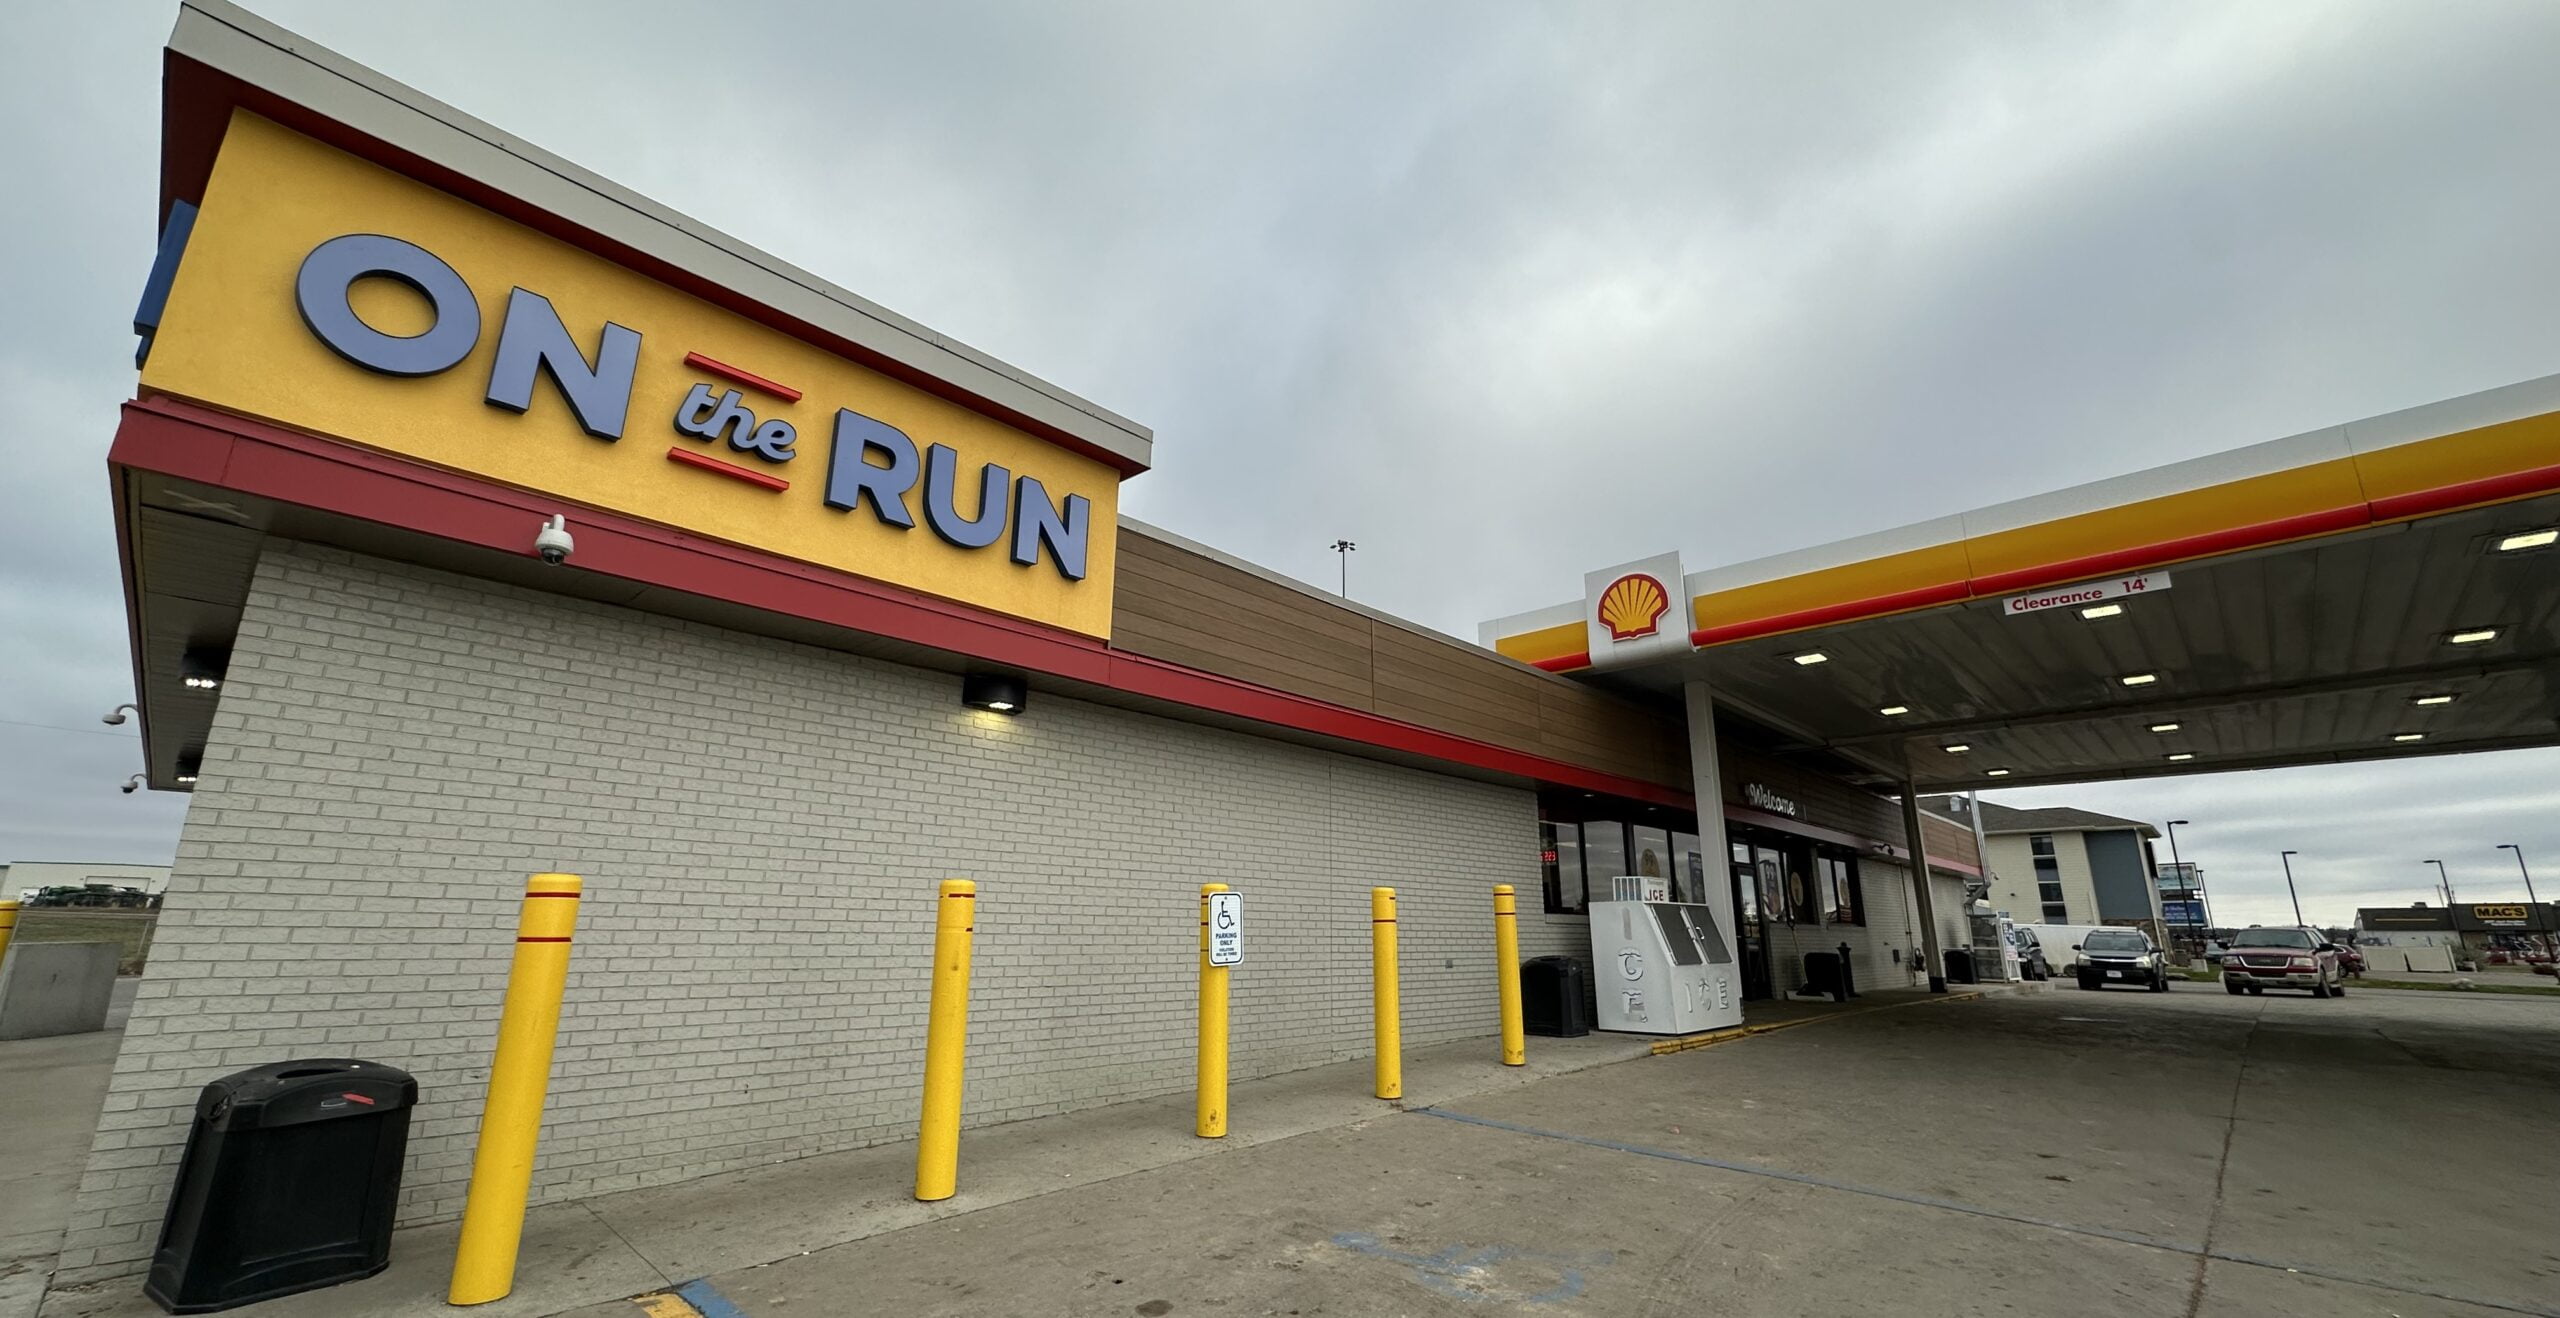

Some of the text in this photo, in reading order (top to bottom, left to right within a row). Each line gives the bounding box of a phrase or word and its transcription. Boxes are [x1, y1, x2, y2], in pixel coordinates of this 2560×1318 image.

[294, 233, 1090, 582] ON the RUN
[2012, 577, 2148, 611] Clearance 14'
[1749, 783, 1796, 816] Welcome
[1648, 889, 1664, 901] ICE
